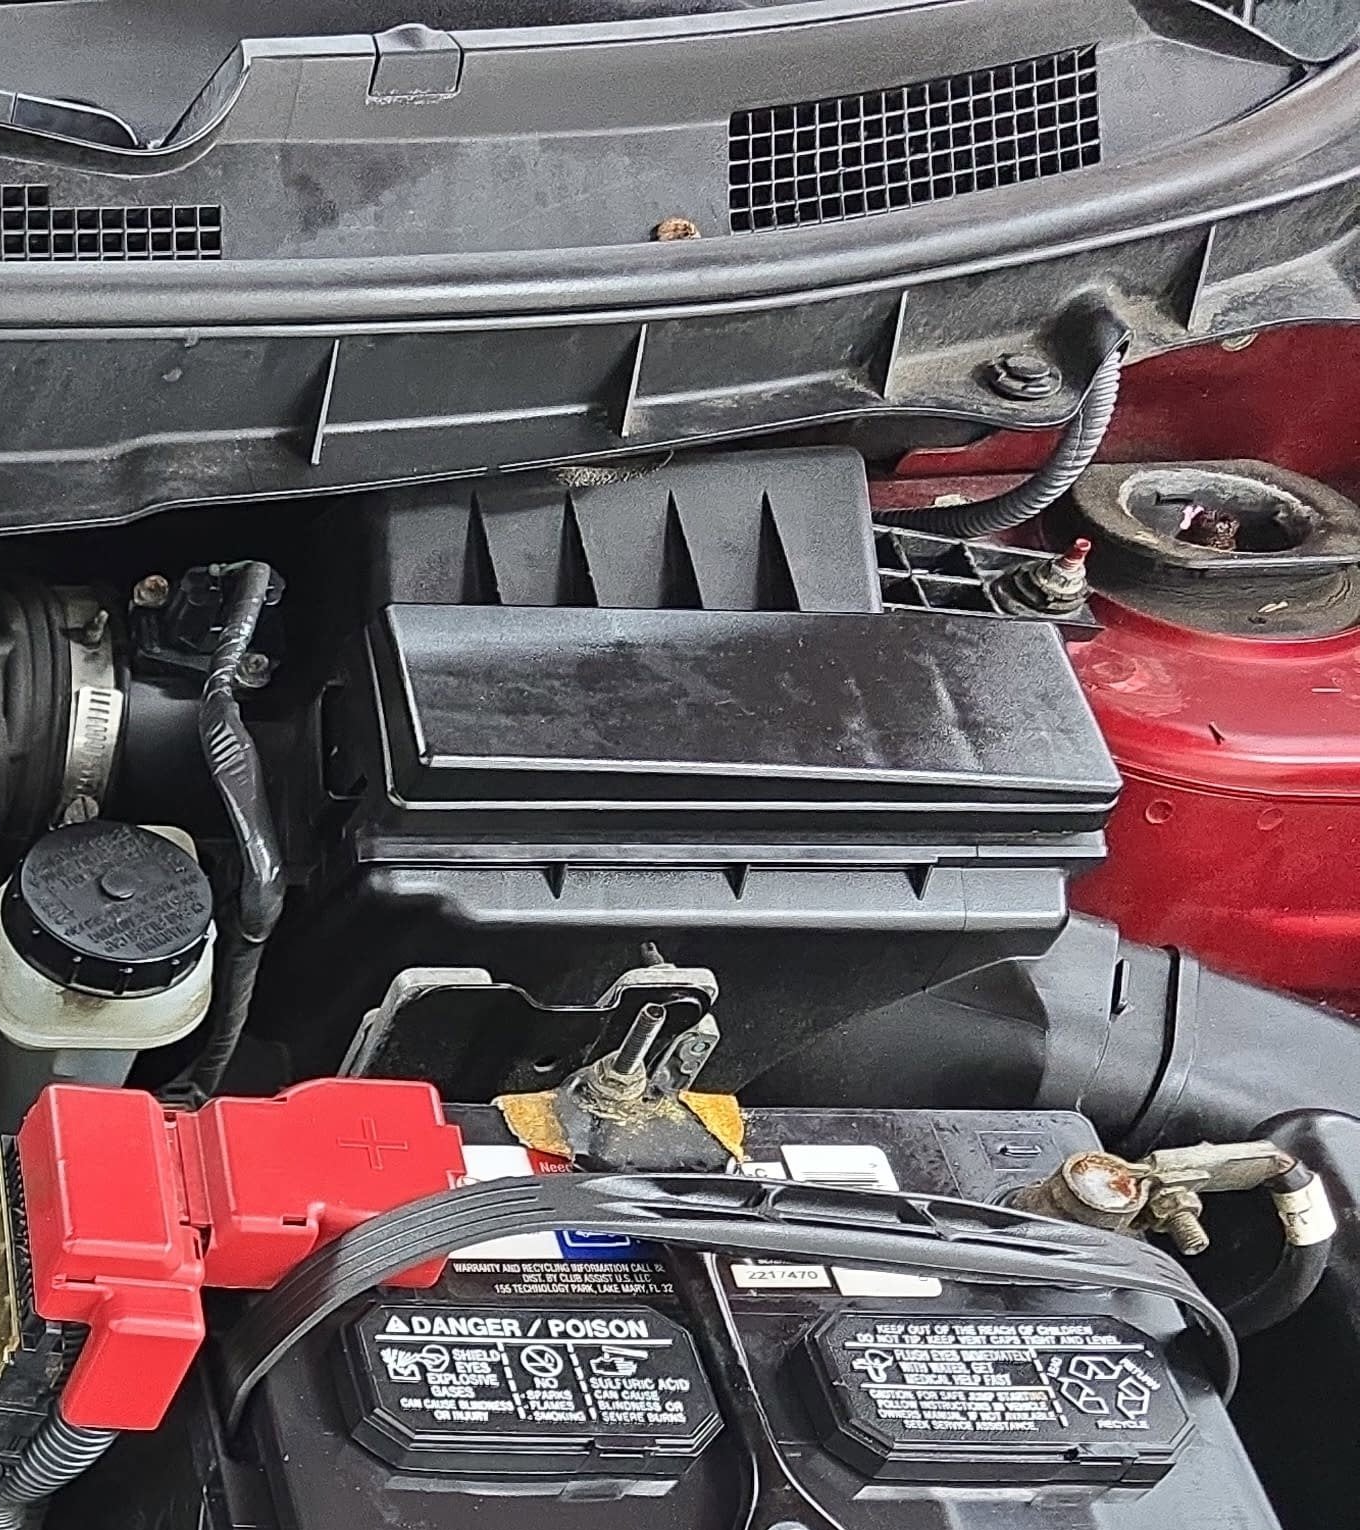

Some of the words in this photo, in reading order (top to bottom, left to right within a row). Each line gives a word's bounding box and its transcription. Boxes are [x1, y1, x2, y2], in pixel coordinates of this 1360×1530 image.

[453, 1263, 501, 1272] WARRANTY
[502, 1264, 521, 1272] AND
[522, 1264, 570, 1272] RECYCLING
[571, 1264, 630, 1273] INFORMATION
[631, 1264, 652, 1273] CALL
[546, 1274, 558, 1283] BY
[560, 1274, 582, 1283] CLUB
[584, 1274, 614, 1283] ASSIST
[616, 1274, 632, 1283] U.S.
[634, 1274, 651, 1283] LLC
[513, 1284, 570, 1293] TECHNOLOGY
[571, 1284, 598, 1294] PARK,
[599, 1284, 620, 1293] LAKE
[411, 1315, 522, 1336] DANGER
[549, 1318, 648, 1338] POISON
[876, 1325, 904, 1334] KEEP
[907, 1325, 930, 1335] OUT
[934, 1326, 949, 1335] OF
[952, 1326, 976, 1335] THE
[978, 1326, 1016, 1335] REACH
[1018, 1326, 1033, 1335] OF
[1037, 1326, 1093, 1335] CHILDREN
[857, 1333, 873, 1343] DO
[876, 1334, 900, 1344] NOT
[925, 1335, 955, 1344] KEEP
[957, 1335, 987, 1345] VENT
[990, 1335, 1020, 1345] CAPS
[1022, 1335, 1056, 1345] TIGHT
[1060, 1336, 1084, 1344] AND
[1086, 1336, 1121, 1344] LEVEL
[452, 1349, 500, 1362] SHIELD
[894, 1350, 930, 1361] FLUSH
[931, 1350, 960, 1361] EYES
[455, 1362, 491, 1373] EYES
[899, 1362, 928, 1373] WITH
[971, 1362, 994, 1373] GET
[426, 1373, 500, 1387] EXPLOSIVE
[534, 1377, 558, 1388] NO
[590, 1377, 655, 1389] SULFURIC
[658, 1379, 690, 1391] ACID
[904, 1374, 952, 1385] MEDICAL
[952, 1374, 981, 1385] HELP
[983, 1374, 1012, 1386] FAST
[431, 1385, 475, 1398] GASES
[527, 1390, 573, 1400] SPARKS
[594, 1390, 619, 1400] CAN
[621, 1391, 660, 1401] CAUSE
[400, 1398, 422, 1409] CAN
[530, 1401, 575, 1411] FLAMES
[598, 1401, 662, 1411] BLINDNESS
[665, 1401, 684, 1412] OR
[533, 1411, 586, 1422] SMOKING
[601, 1411, 645, 1422] SEVERE
[647, 1412, 686, 1423] BURNS
[1096, 1420, 1150, 1429] RECYCLE
